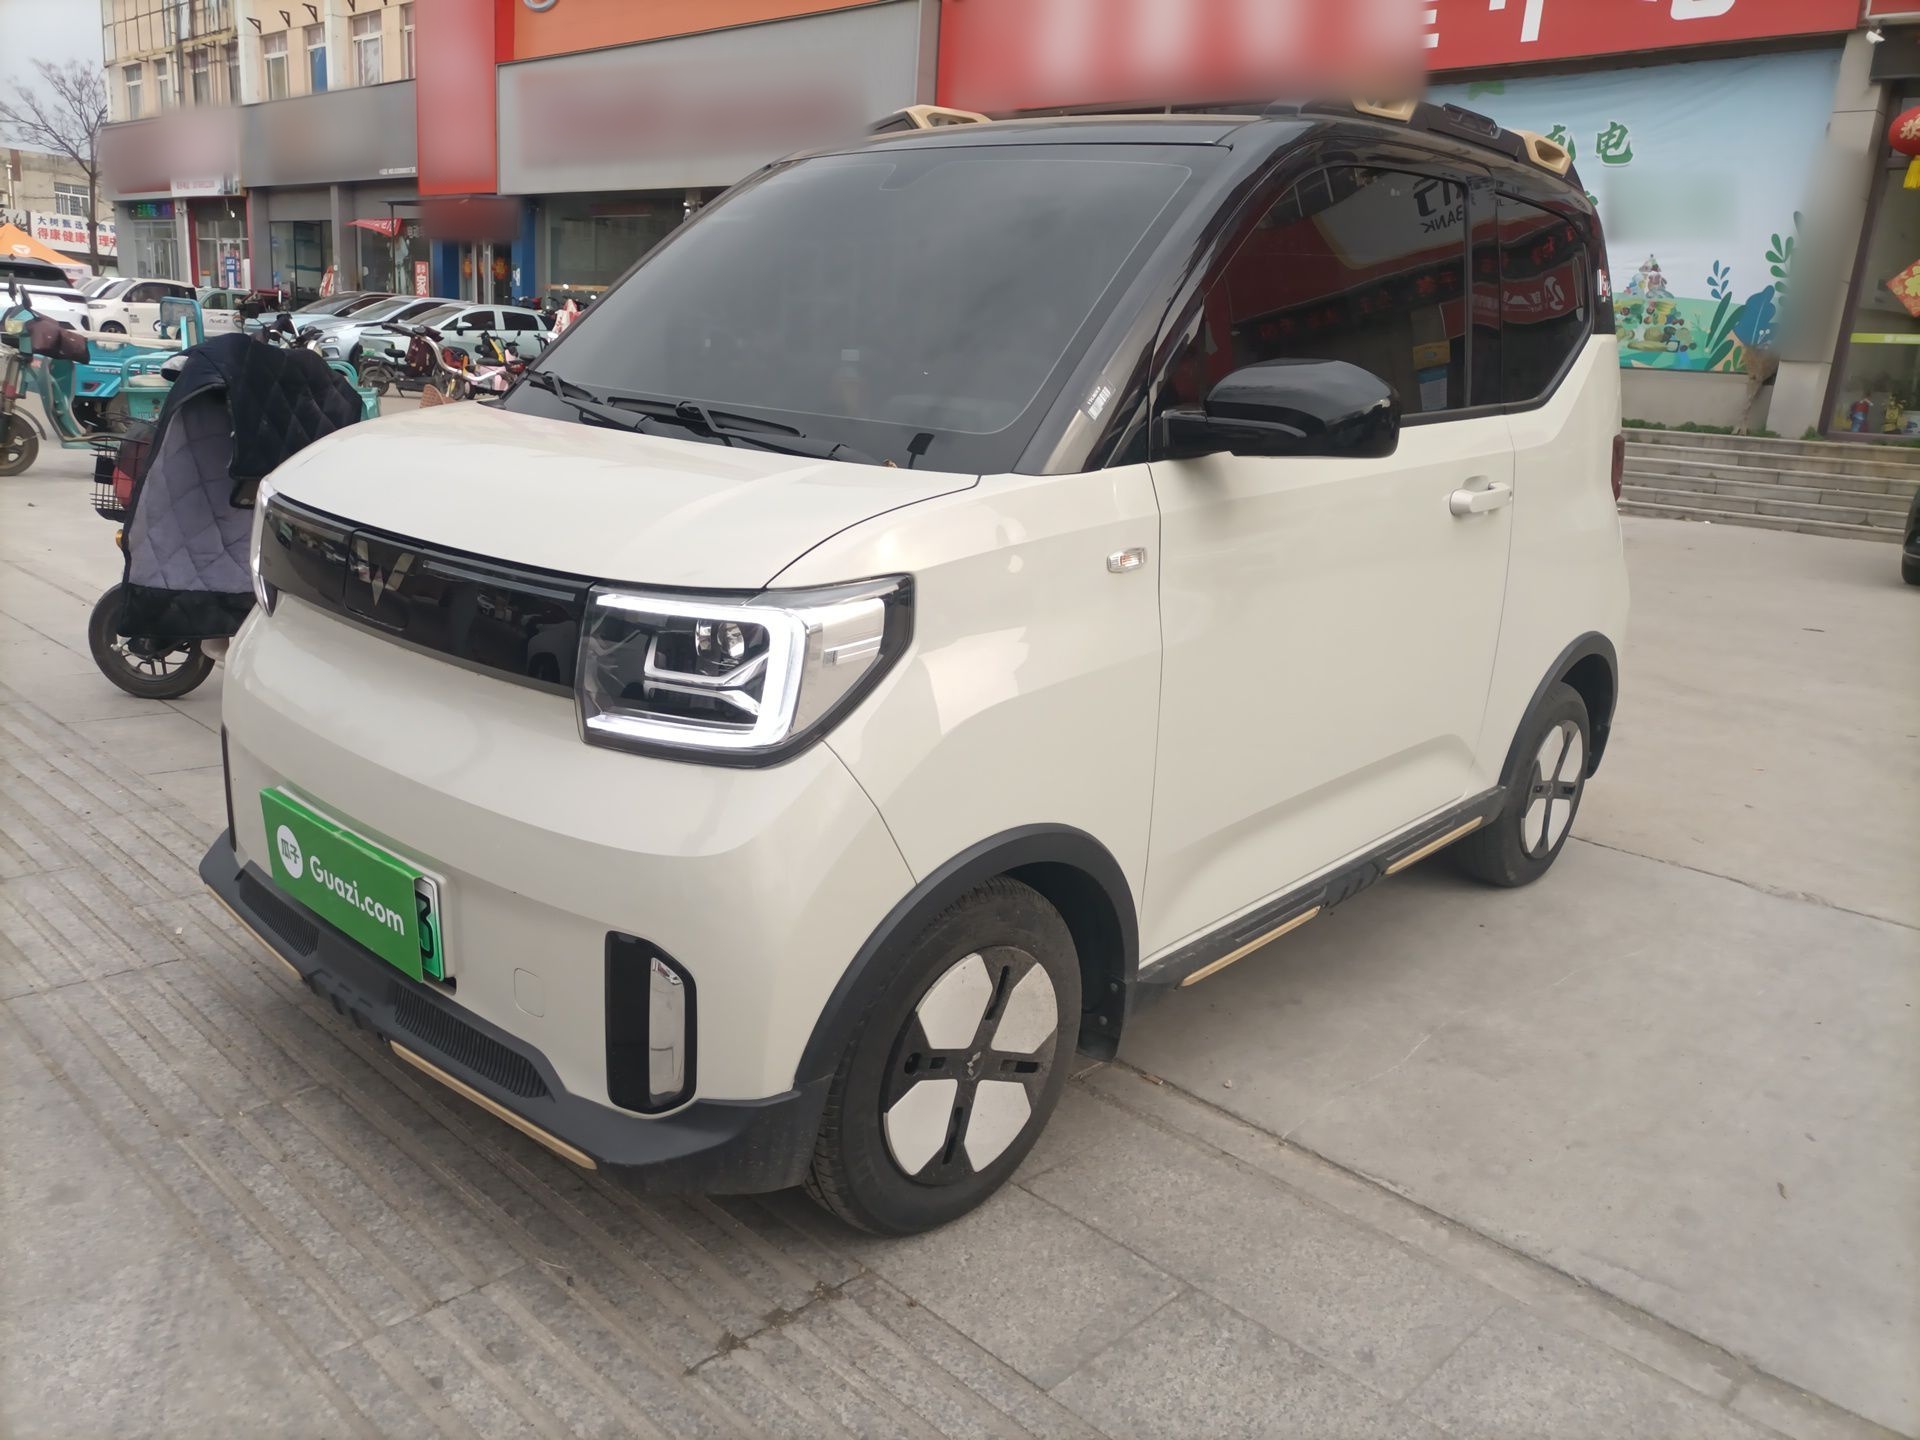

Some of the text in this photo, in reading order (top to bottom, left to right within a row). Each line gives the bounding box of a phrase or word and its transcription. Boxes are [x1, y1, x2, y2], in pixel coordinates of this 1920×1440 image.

[38, 227, 117, 247] 得康健康理中
[281, 838, 300, 864] 瓜子
[310, 855, 404, 936] Guazi.com
